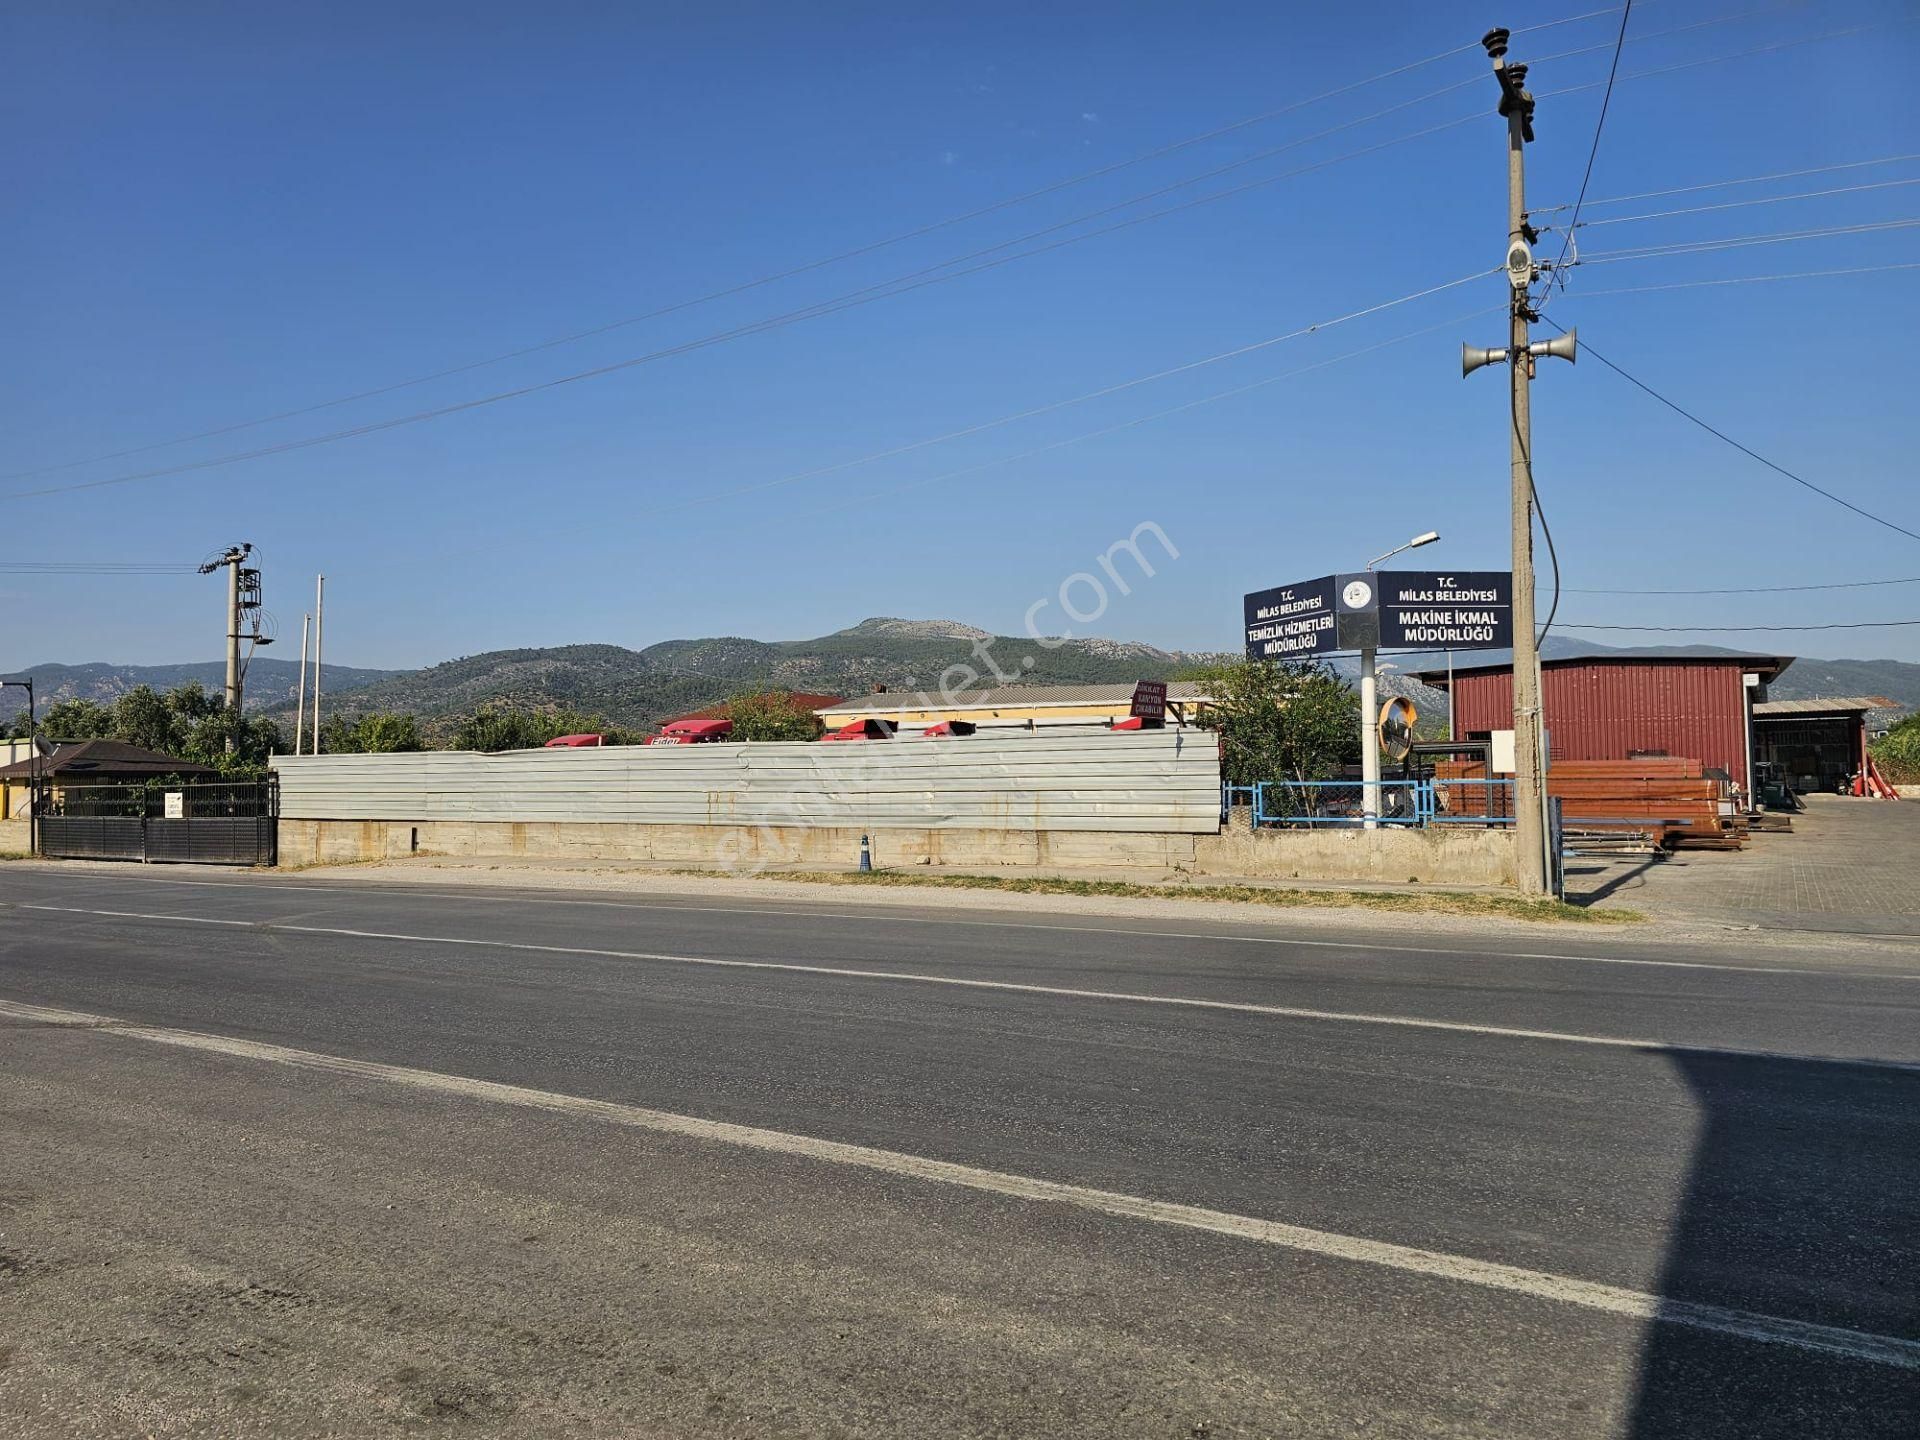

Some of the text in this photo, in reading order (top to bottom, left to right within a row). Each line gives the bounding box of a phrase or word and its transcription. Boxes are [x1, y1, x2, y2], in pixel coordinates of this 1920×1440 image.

[1437, 577, 1457, 588] T.C.
[1280, 589, 1295, 601] T.C.
[1399, 589, 1497, 602] MİLAS BELEDİYESİ
[1256, 598, 1322, 619] MİLAS BELEDİYESİ
[1399, 609, 1498, 625] MAKİNE İKMAL
[1248, 613, 1334, 641] TEMİZLİK HİZMETLERİ
[1404, 624, 1493, 641] MÜDÜRLÜĞÜ
[1264, 633, 1317, 655] MÜDÜRLÜĞÜ
